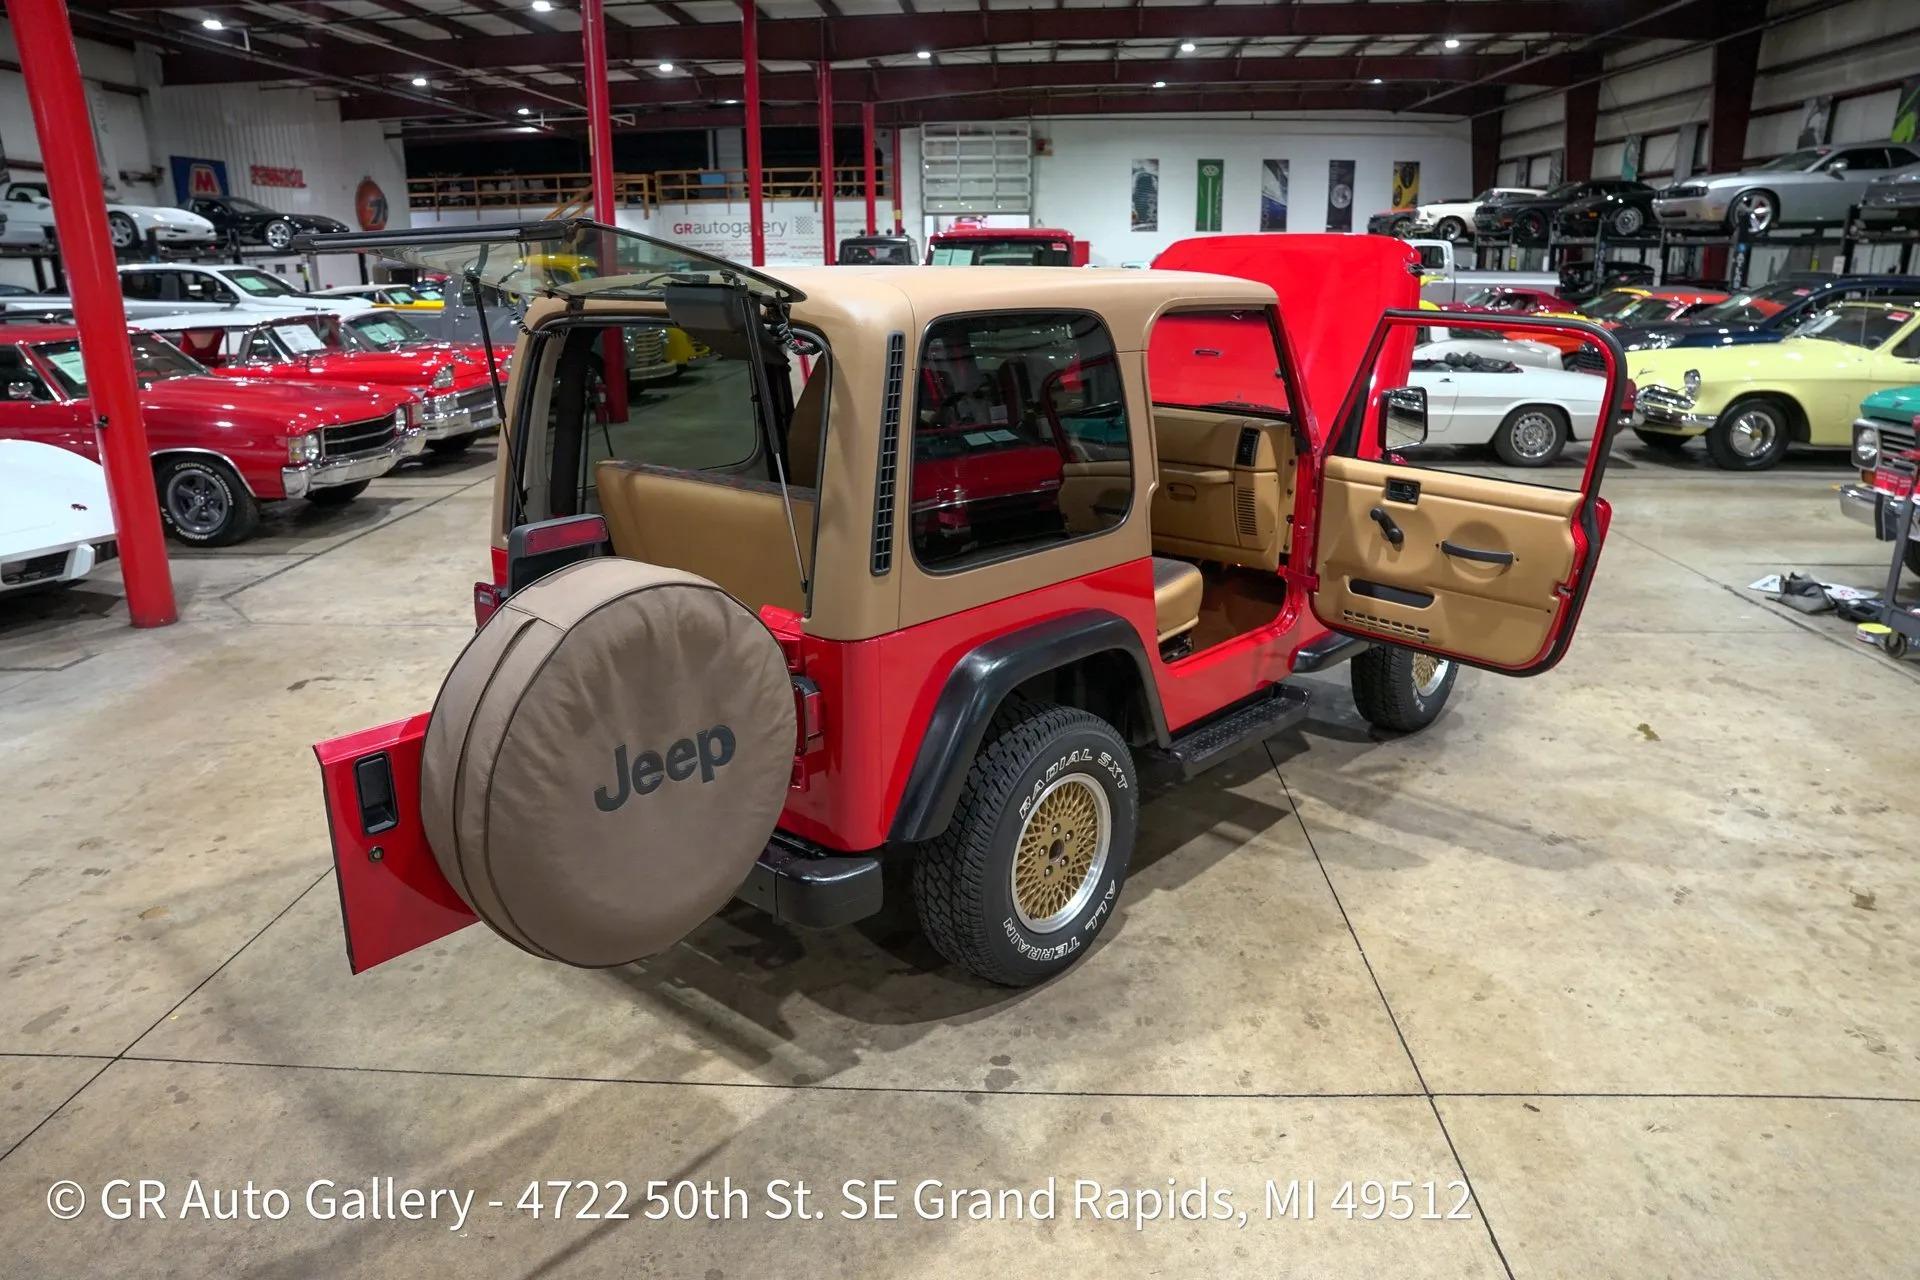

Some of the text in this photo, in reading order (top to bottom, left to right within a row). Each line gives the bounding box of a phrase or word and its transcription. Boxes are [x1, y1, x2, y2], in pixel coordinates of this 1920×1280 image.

[195, 167, 217, 192] M
[594, 725, 737, 812] Jeep
[1019, 748, 1129, 820] RADIAL SXT
[1003, 879, 1116, 961] ALL TERRAIN
